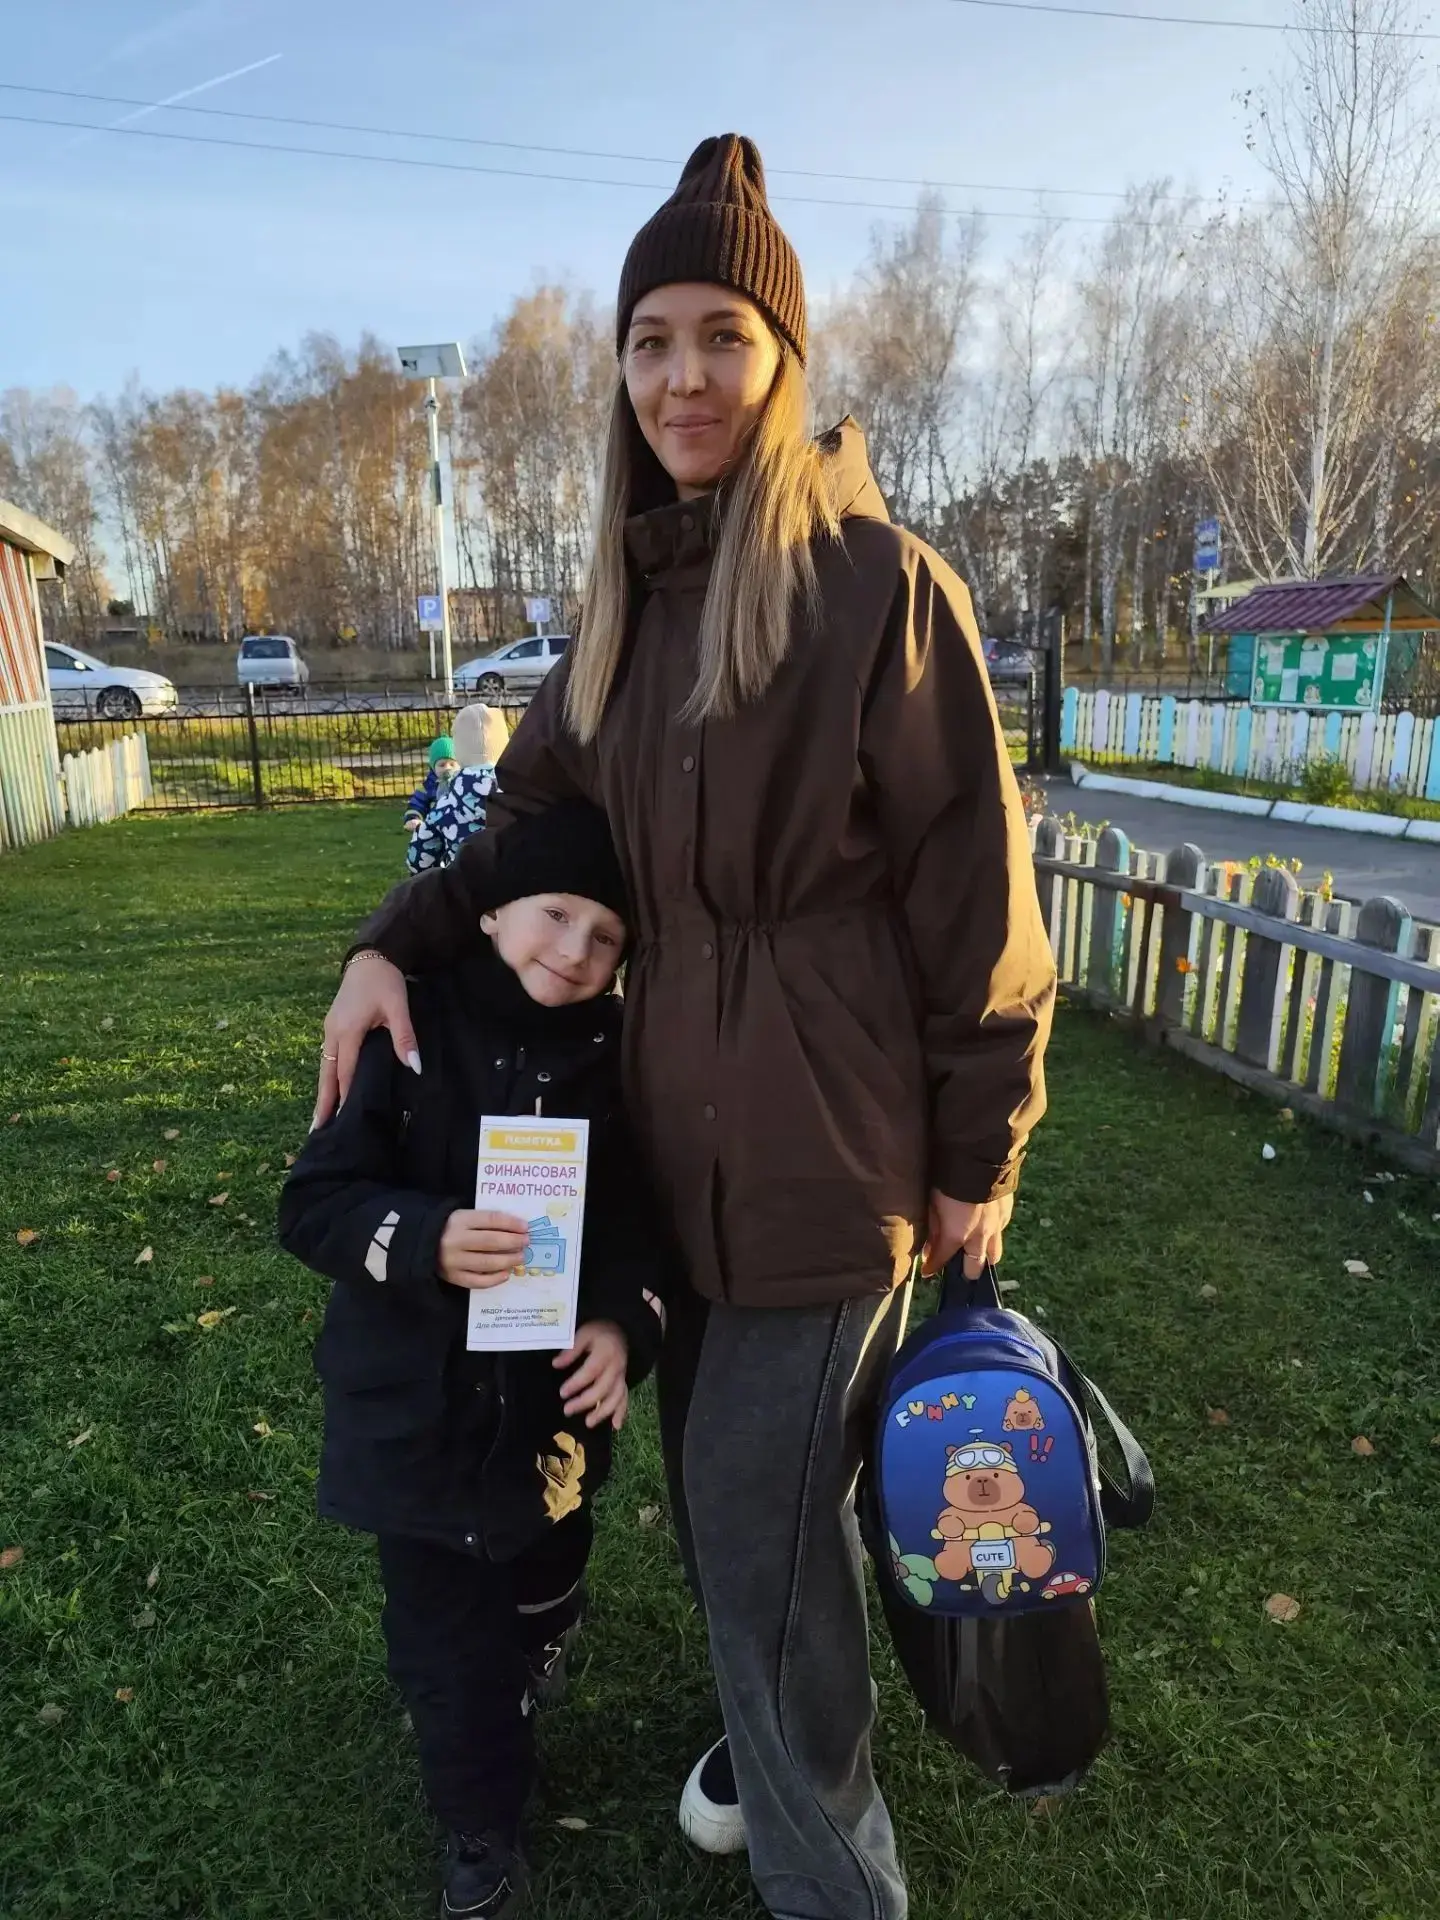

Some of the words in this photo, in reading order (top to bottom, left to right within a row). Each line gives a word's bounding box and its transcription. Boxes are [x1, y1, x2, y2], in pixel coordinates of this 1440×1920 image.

[424, 599, 437, 617] P
[532, 601, 544, 618] P
[484, 1164, 577, 1178] ФИНАНСОВАЯ
[481, 1182, 578, 1196] ГРАМОТНОСТЬ
[895, 1392, 978, 1428] FUNNY
[976, 1552, 1005, 1562] CUTE
